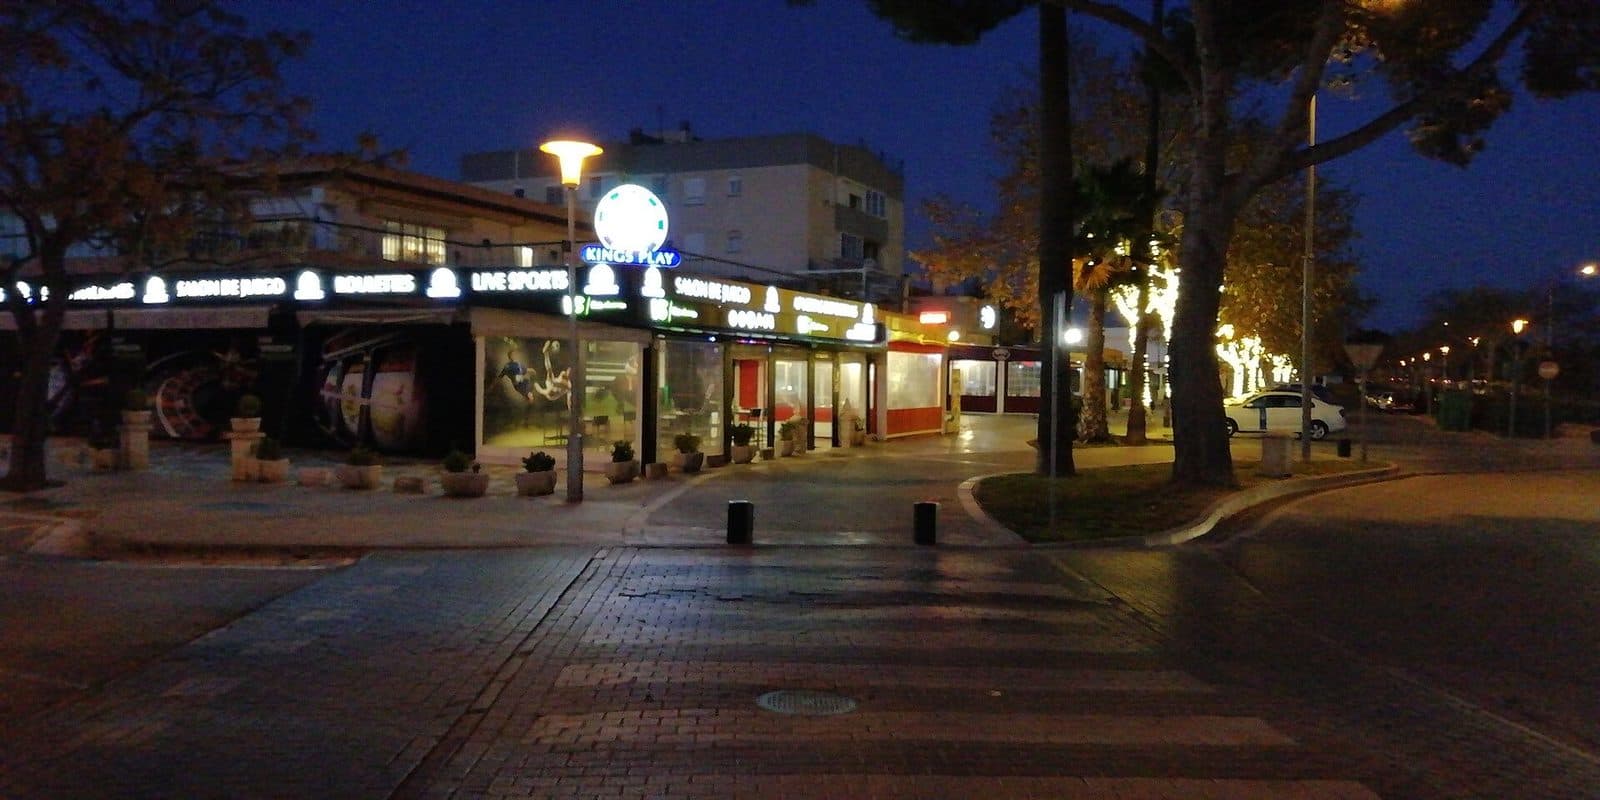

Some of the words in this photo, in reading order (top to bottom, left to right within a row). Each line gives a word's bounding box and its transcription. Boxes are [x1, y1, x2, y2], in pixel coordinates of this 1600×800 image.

[586, 247, 634, 263] KINGS
[638, 249, 675, 265] PLAY
[221, 279, 239, 296] DE
[472, 272, 506, 291] LIVE
[507, 270, 569, 290] SPORTS
